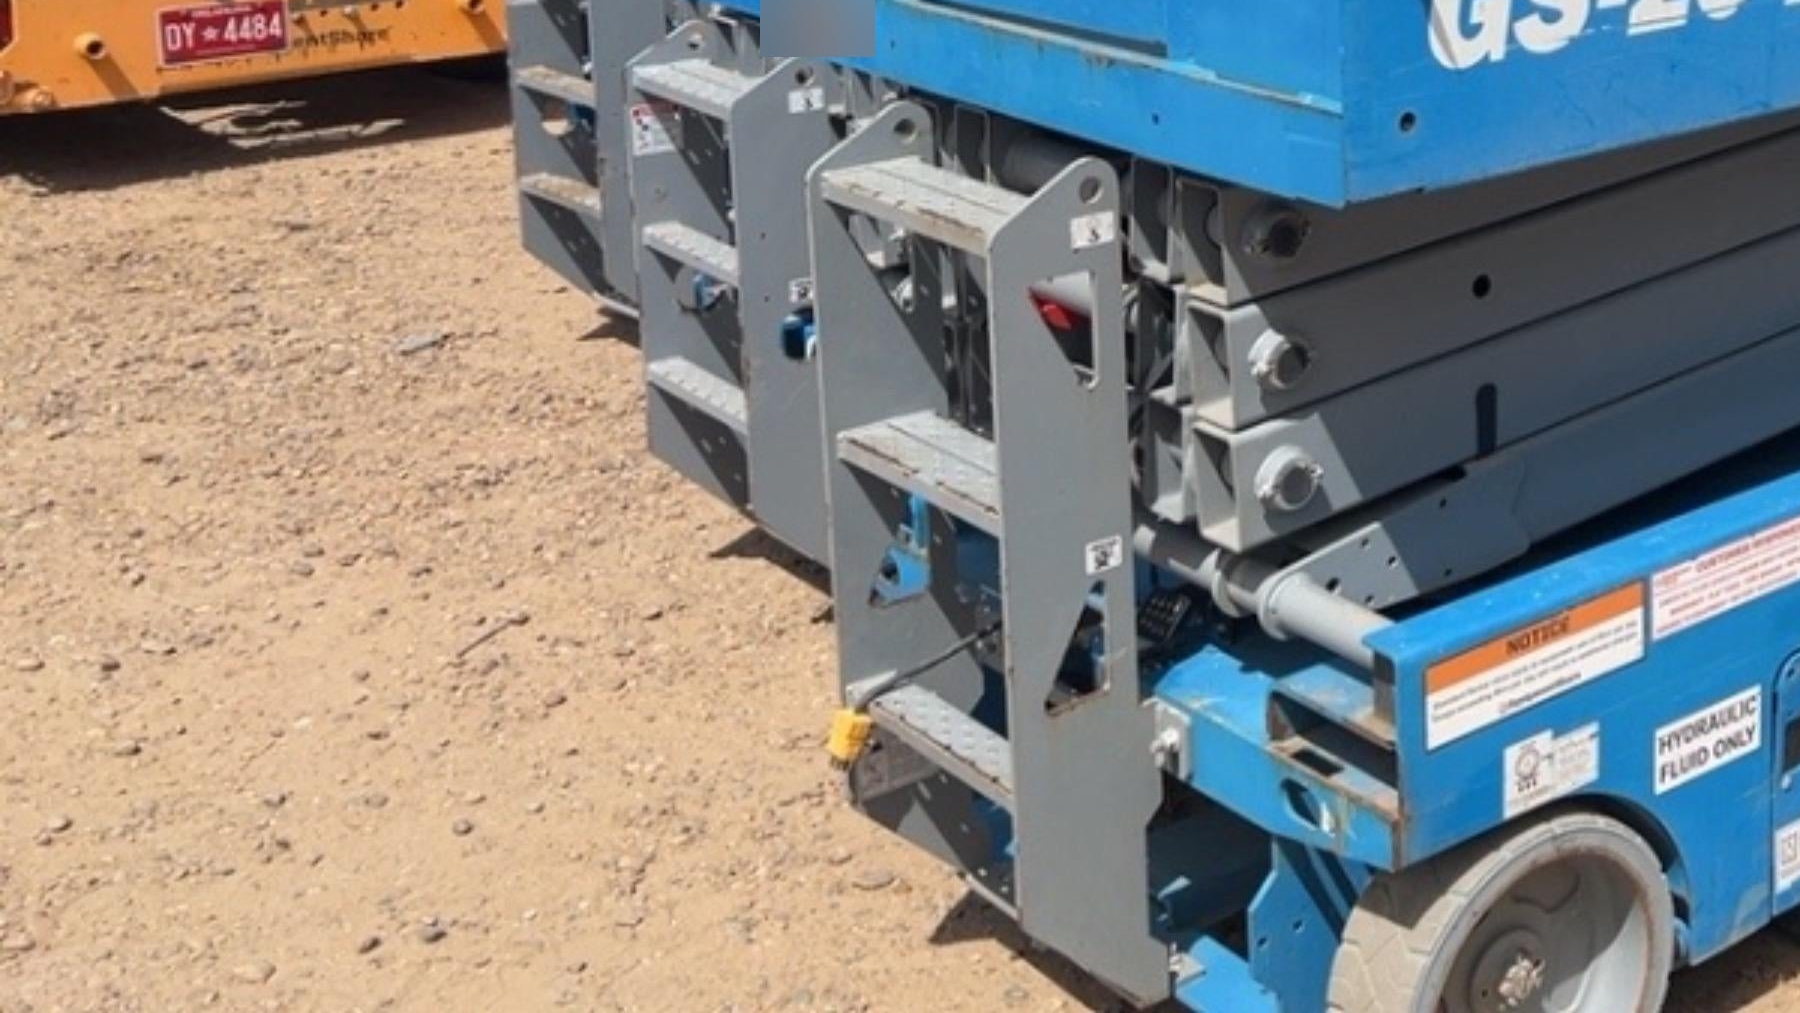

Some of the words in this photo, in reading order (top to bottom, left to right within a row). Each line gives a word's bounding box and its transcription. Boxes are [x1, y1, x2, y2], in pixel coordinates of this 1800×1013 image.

[164, 22, 195, 51] DY
[1505, 615, 1571, 657] NOTICE
[1658, 695, 1757, 756] HYDRAULIC
[1659, 746, 1711, 784] FLUID
[1713, 723, 1757, 758] ONLY
